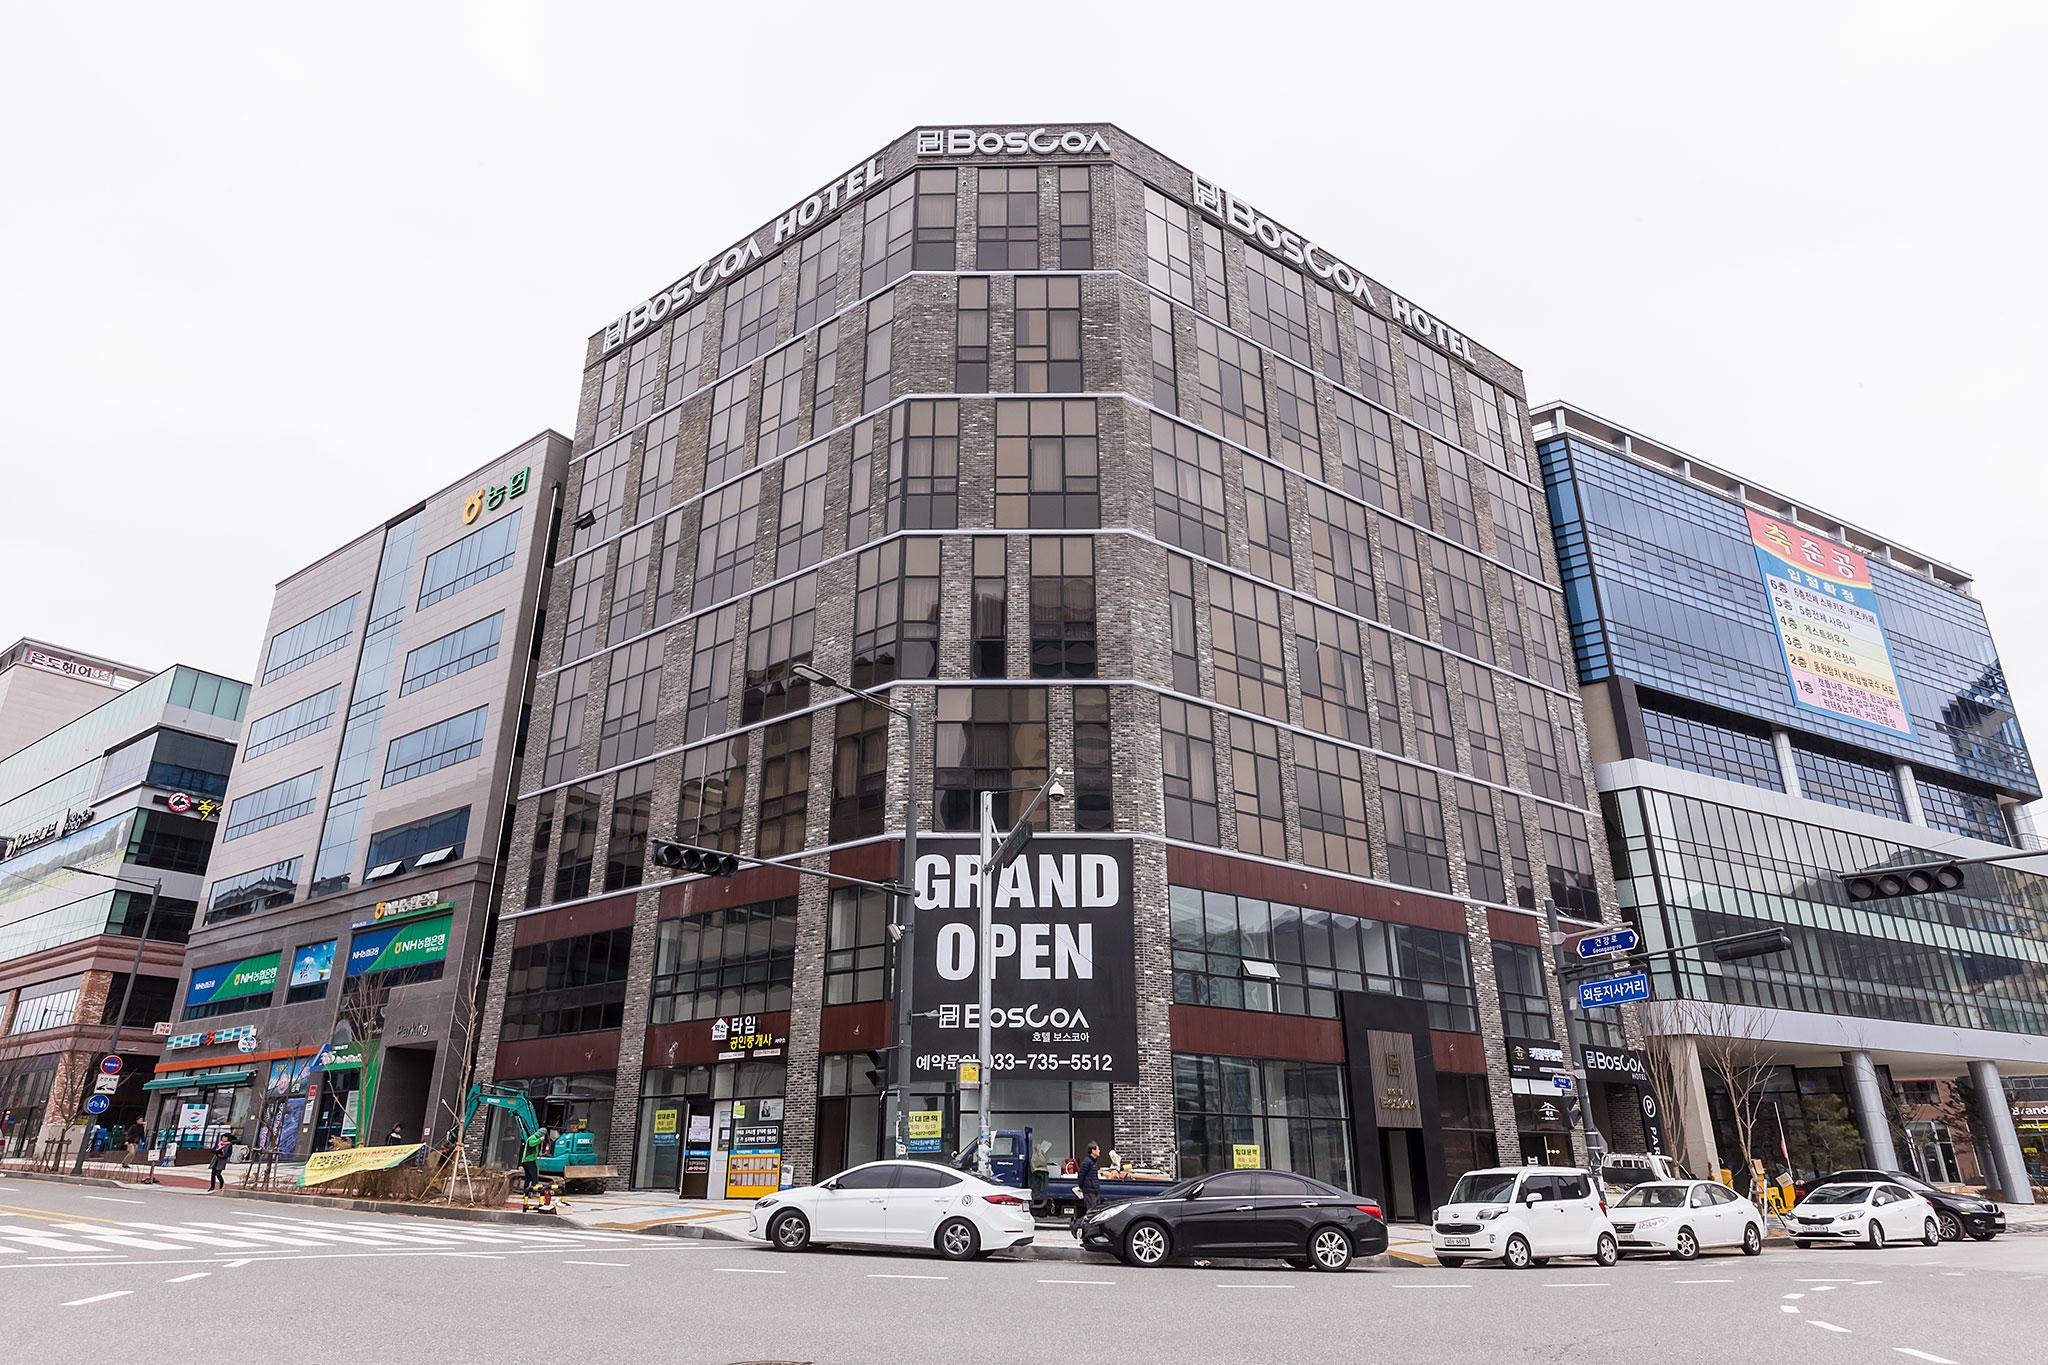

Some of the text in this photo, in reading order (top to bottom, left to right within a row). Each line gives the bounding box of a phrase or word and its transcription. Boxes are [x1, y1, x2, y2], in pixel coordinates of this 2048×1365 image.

[773, 157, 886, 245] HOTEL
[1390, 293, 1477, 366] HOTEL
[487, 466, 530, 511] 농협
[1769, 578, 1788, 594] 6층
[1774, 595, 1793, 611] 5층
[1778, 614, 1798, 630] 4층
[1784, 633, 1803, 649] 3층
[1789, 653, 1808, 669] 2층
[1796, 679, 1814, 694] 1층
[914, 853, 1120, 911] GRAND
[1594, 934, 1618, 947] 건강로
[1628, 935, 1634, 943] 9
[936, 922, 1093, 981] OPEN
[1583, 979, 1645, 1002] 외둔지사거리
[731, 1015, 756, 1035] 타임
[730, 1033, 772, 1050] 공인중개사
[1031, 1031, 1090, 1043] 호텔 보스코아
[1632, 1073, 1647, 1081] HOTEL
